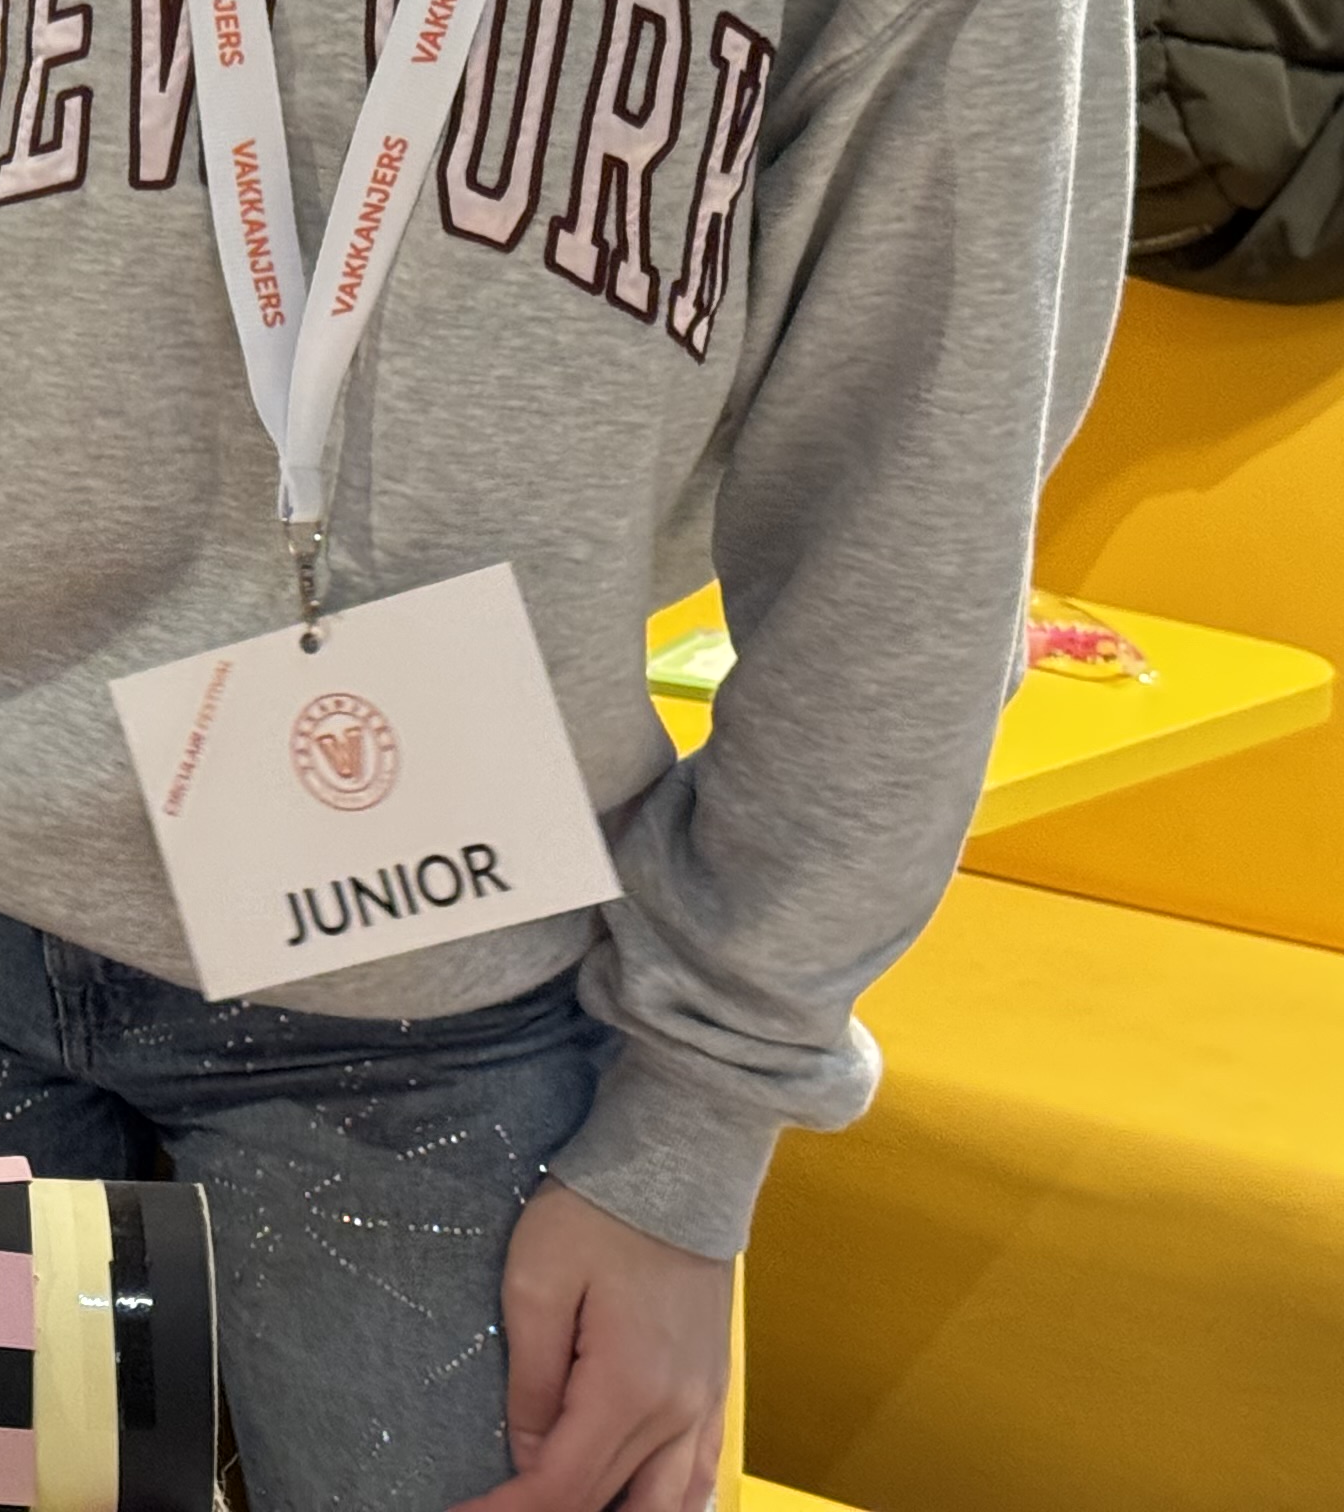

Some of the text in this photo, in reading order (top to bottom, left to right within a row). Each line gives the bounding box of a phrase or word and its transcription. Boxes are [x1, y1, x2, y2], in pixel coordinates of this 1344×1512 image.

[230, 138, 286, 331] VAKKANJERS
[331, 134, 409, 317] VAKKANJERS
[285, 842, 512, 947] JUNIOR
